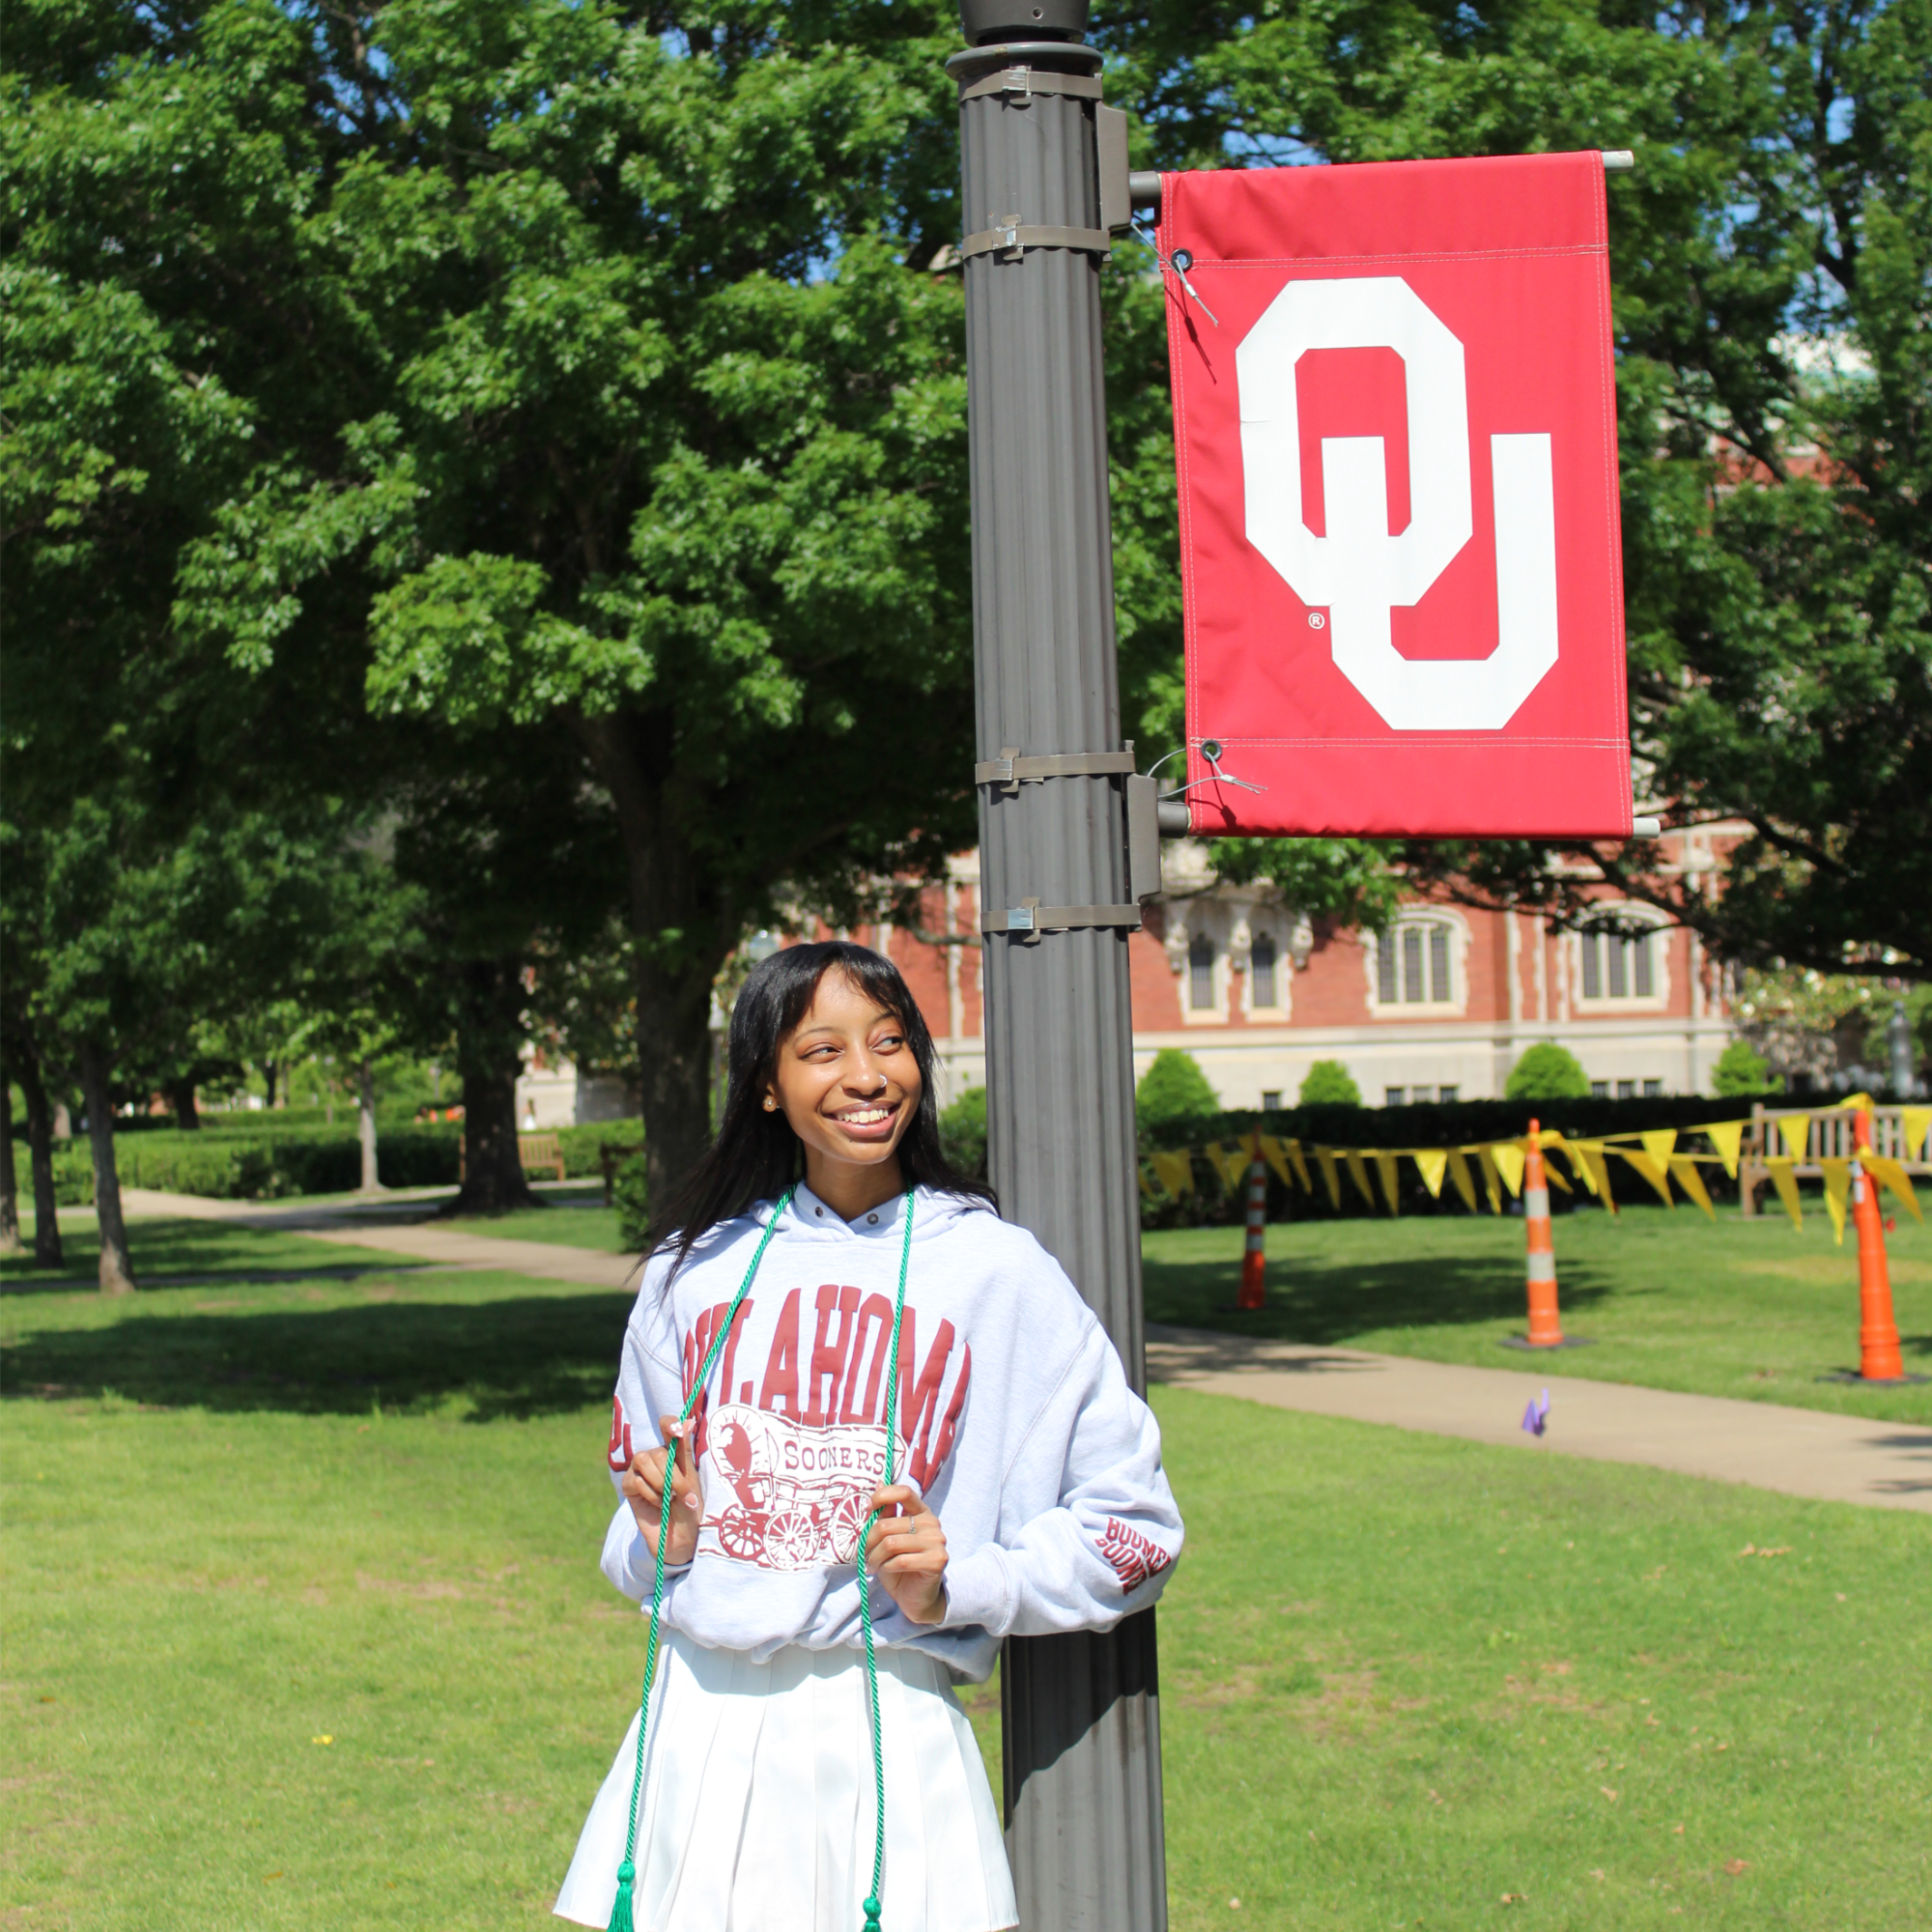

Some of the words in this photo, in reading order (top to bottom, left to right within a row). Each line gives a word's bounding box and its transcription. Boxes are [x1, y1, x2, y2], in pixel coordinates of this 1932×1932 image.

[1236, 276, 1559, 730] OU
[782, 1439, 886, 1476] SOONERS
[1094, 1538, 1148, 1597] SOONE
